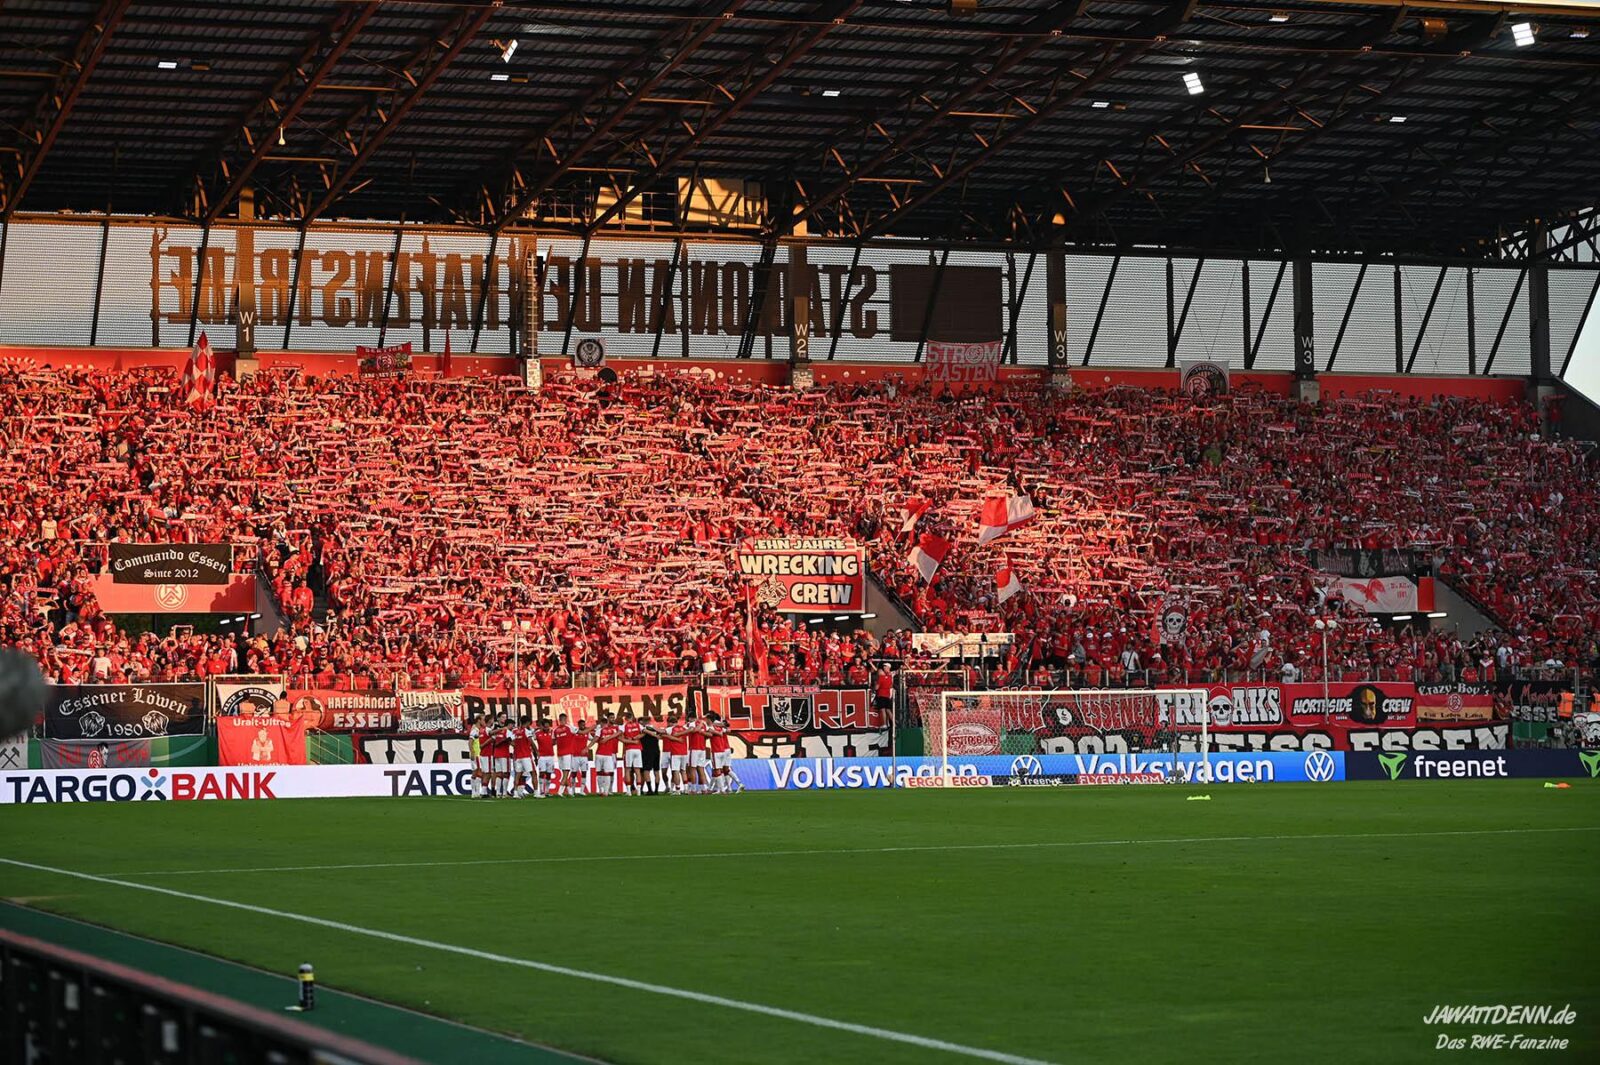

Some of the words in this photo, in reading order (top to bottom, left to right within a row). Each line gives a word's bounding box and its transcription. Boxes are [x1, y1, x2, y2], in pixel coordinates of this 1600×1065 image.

[240, 311, 254, 325] W
[243, 326, 250, 342] 1
[794, 323, 808, 337] W
[1054, 330, 1067, 343] W
[796, 338, 807, 354] 2
[1301, 336, 1313, 349] W
[1056, 345, 1066, 360] 3
[1303, 350, 1313, 365] 3
[926, 362, 998, 383] KASTEN
[791, 538, 847, 551] JAHRE
[114, 549, 185, 572] Commando
[188, 551, 228, 574] Essen
[739, 553, 859, 577] WRECKING
[143, 567, 173, 579] Since
[174, 567, 200, 579] 2012
[790, 582, 853, 606] CREW
[58, 691, 127, 716] Essener
[131, 686, 188, 716] Löwen
[223, 694, 237, 713] ALTE
[327, 695, 397, 711] HAFENSÄNGER
[593, 691, 684, 724] FANS
[1381, 698, 1413, 714] CREW
[333, 711, 393, 729] ESSEN
[105, 722, 144, 737] 1980
[768, 757, 979, 789] Volkswagen
[1073, 752, 1275, 784] Volkswagen
[1413, 754, 1509, 778] freenet
[6, 773, 136, 804] TARGO
[172, 771, 278, 800] BANK
[908, 776, 944, 787] ERGO
[951, 775, 990, 787] ERGO
